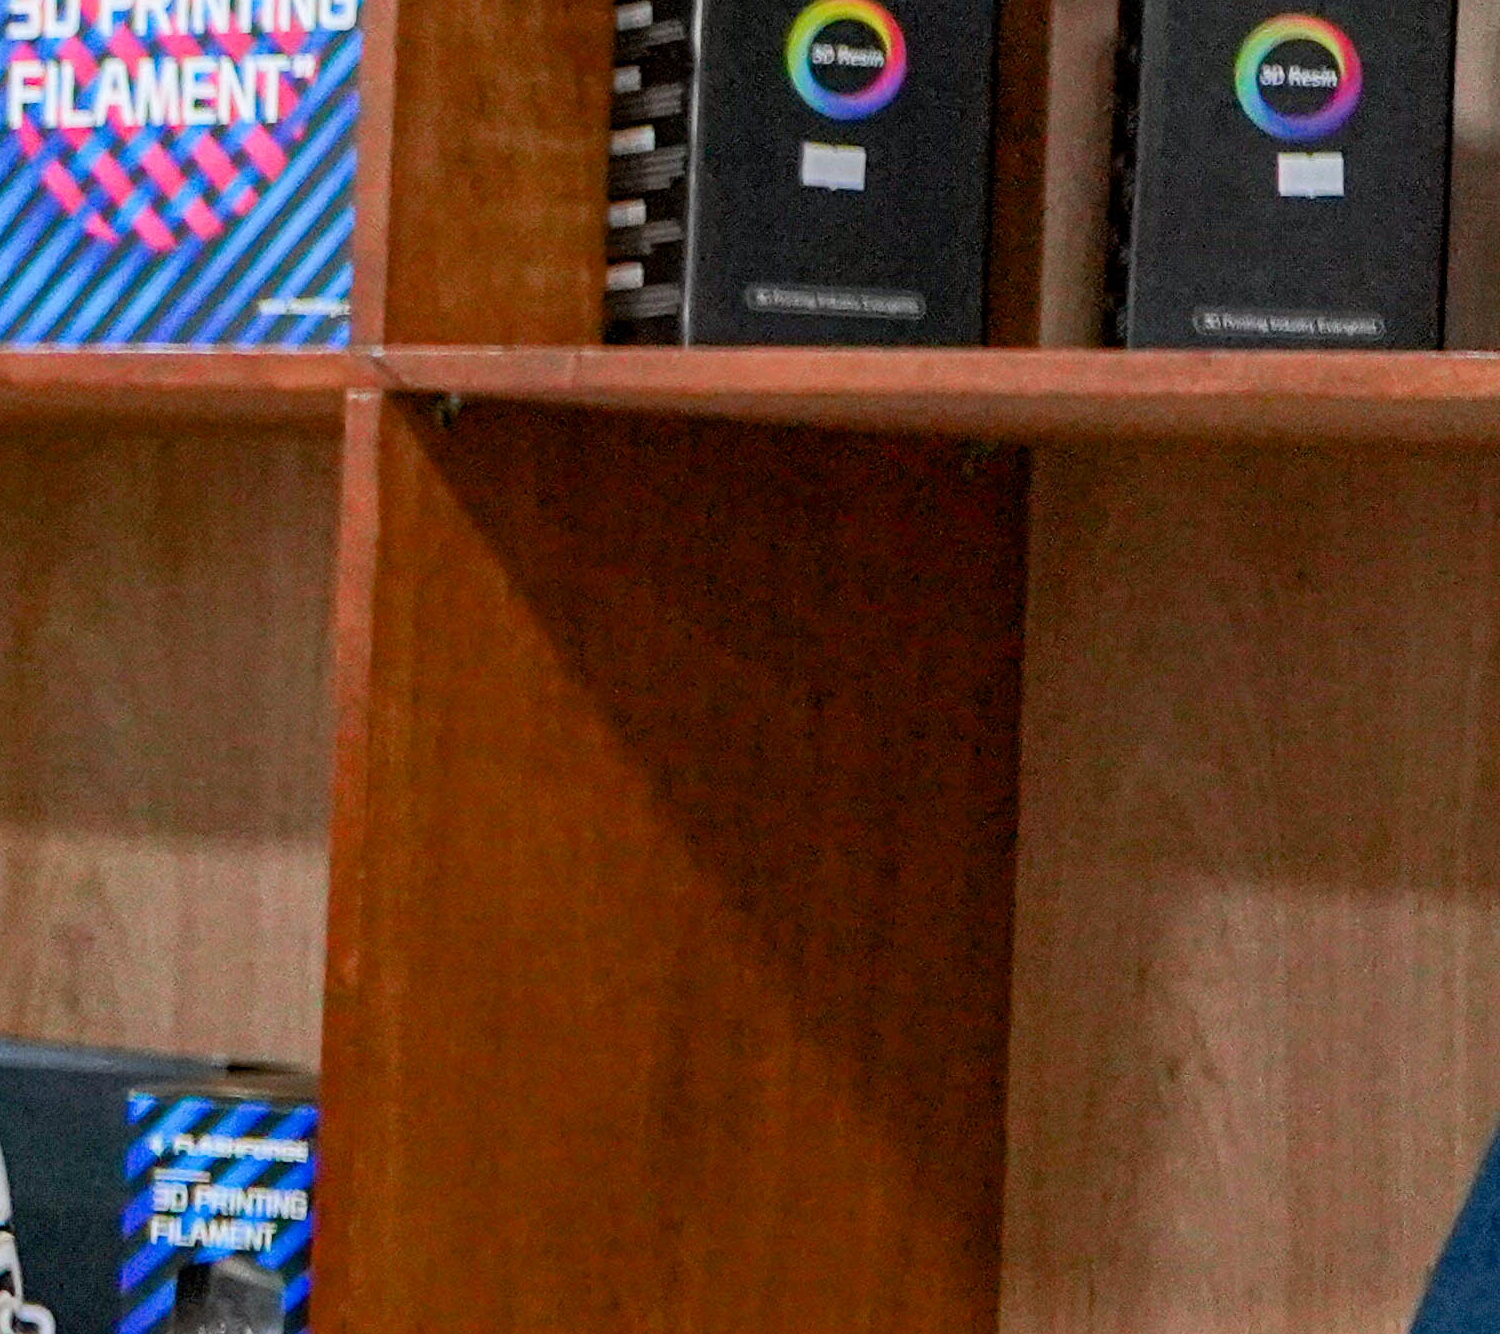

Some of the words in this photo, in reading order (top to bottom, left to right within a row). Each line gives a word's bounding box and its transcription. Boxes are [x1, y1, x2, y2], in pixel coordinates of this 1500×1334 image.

[152, 1181, 189, 1213] 3D
[193, 1183, 309, 1221] PRINTING
[150, 1213, 278, 1252] FILAMENT
